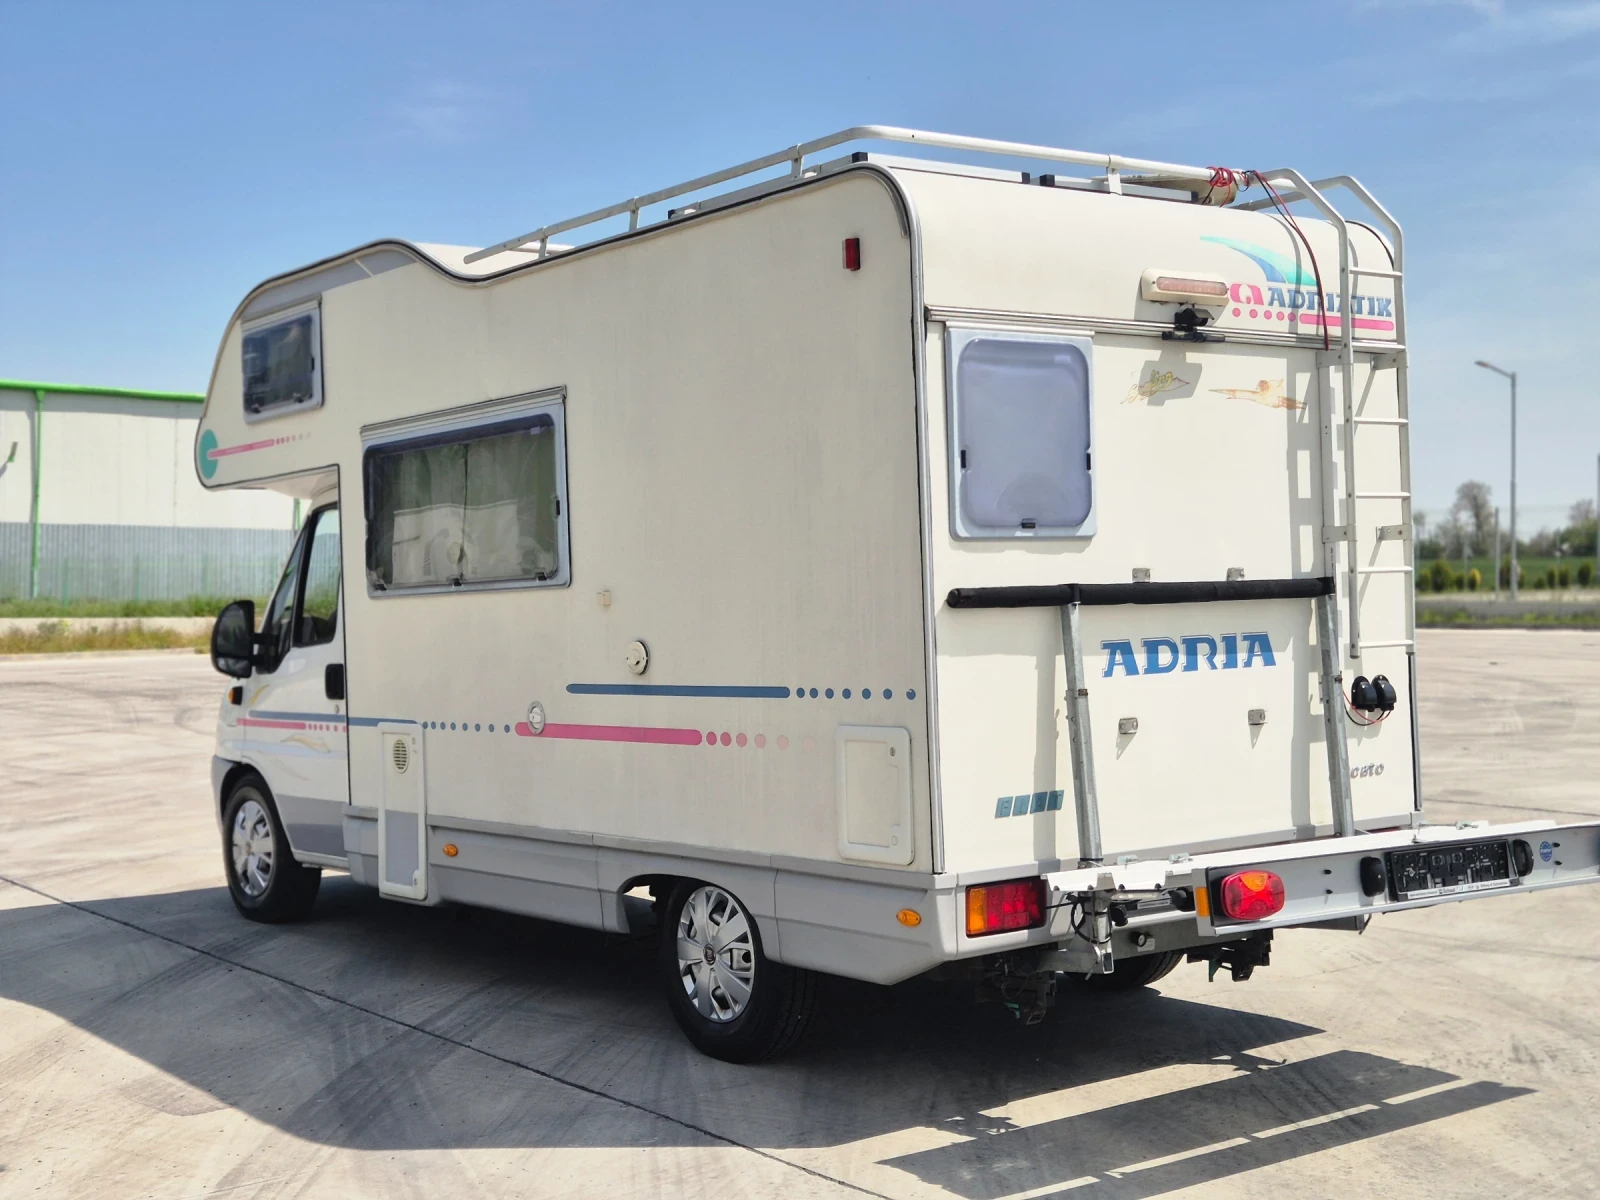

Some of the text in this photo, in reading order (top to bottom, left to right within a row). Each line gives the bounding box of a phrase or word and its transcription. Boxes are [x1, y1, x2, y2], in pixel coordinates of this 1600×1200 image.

[1101, 632, 1276, 677] ADRIA
[1350, 763, 1384, 779] cato
[996, 791, 1064, 818] FIAT
